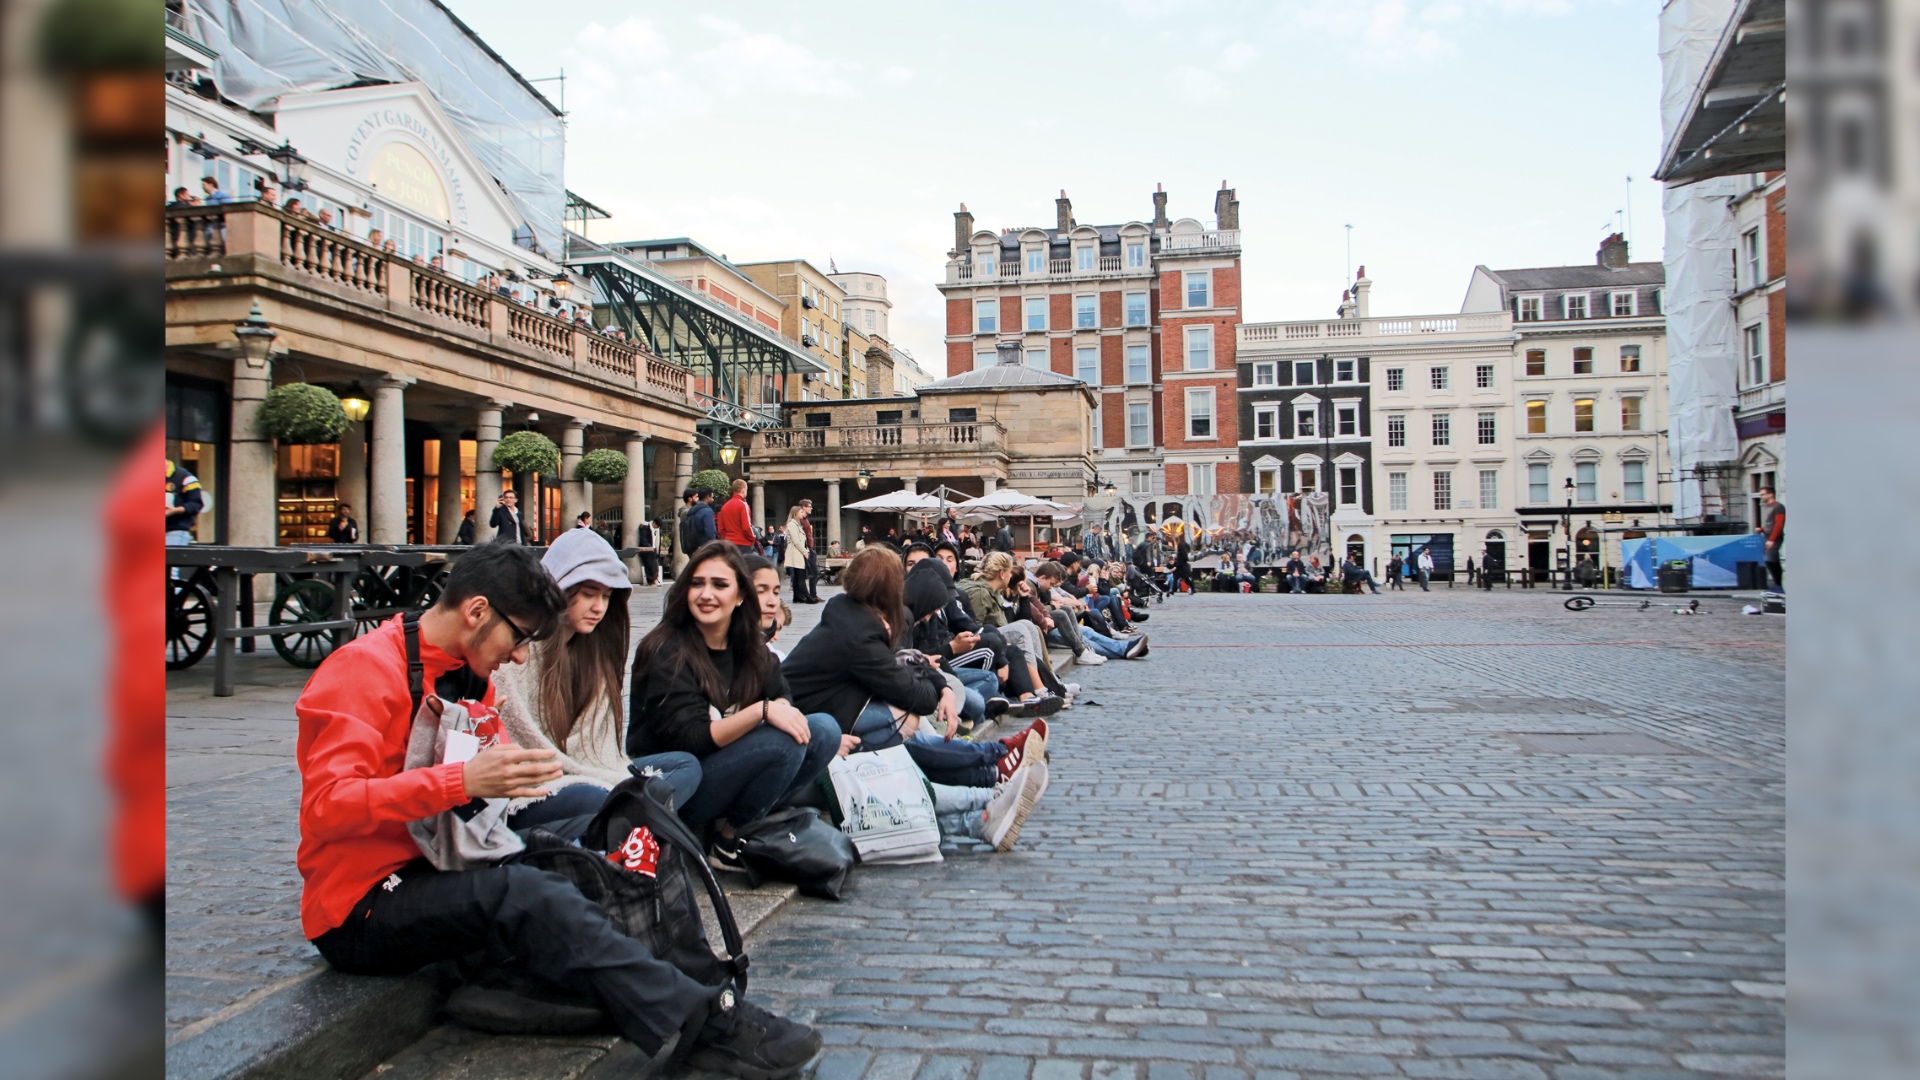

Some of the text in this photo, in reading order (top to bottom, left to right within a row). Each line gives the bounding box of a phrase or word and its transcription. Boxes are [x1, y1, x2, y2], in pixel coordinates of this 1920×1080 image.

[345, 109, 468, 226] COVENT GARDEN MARKET
[386, 151, 432, 187] PUNCH
[386, 176, 432, 208] & JUDY
